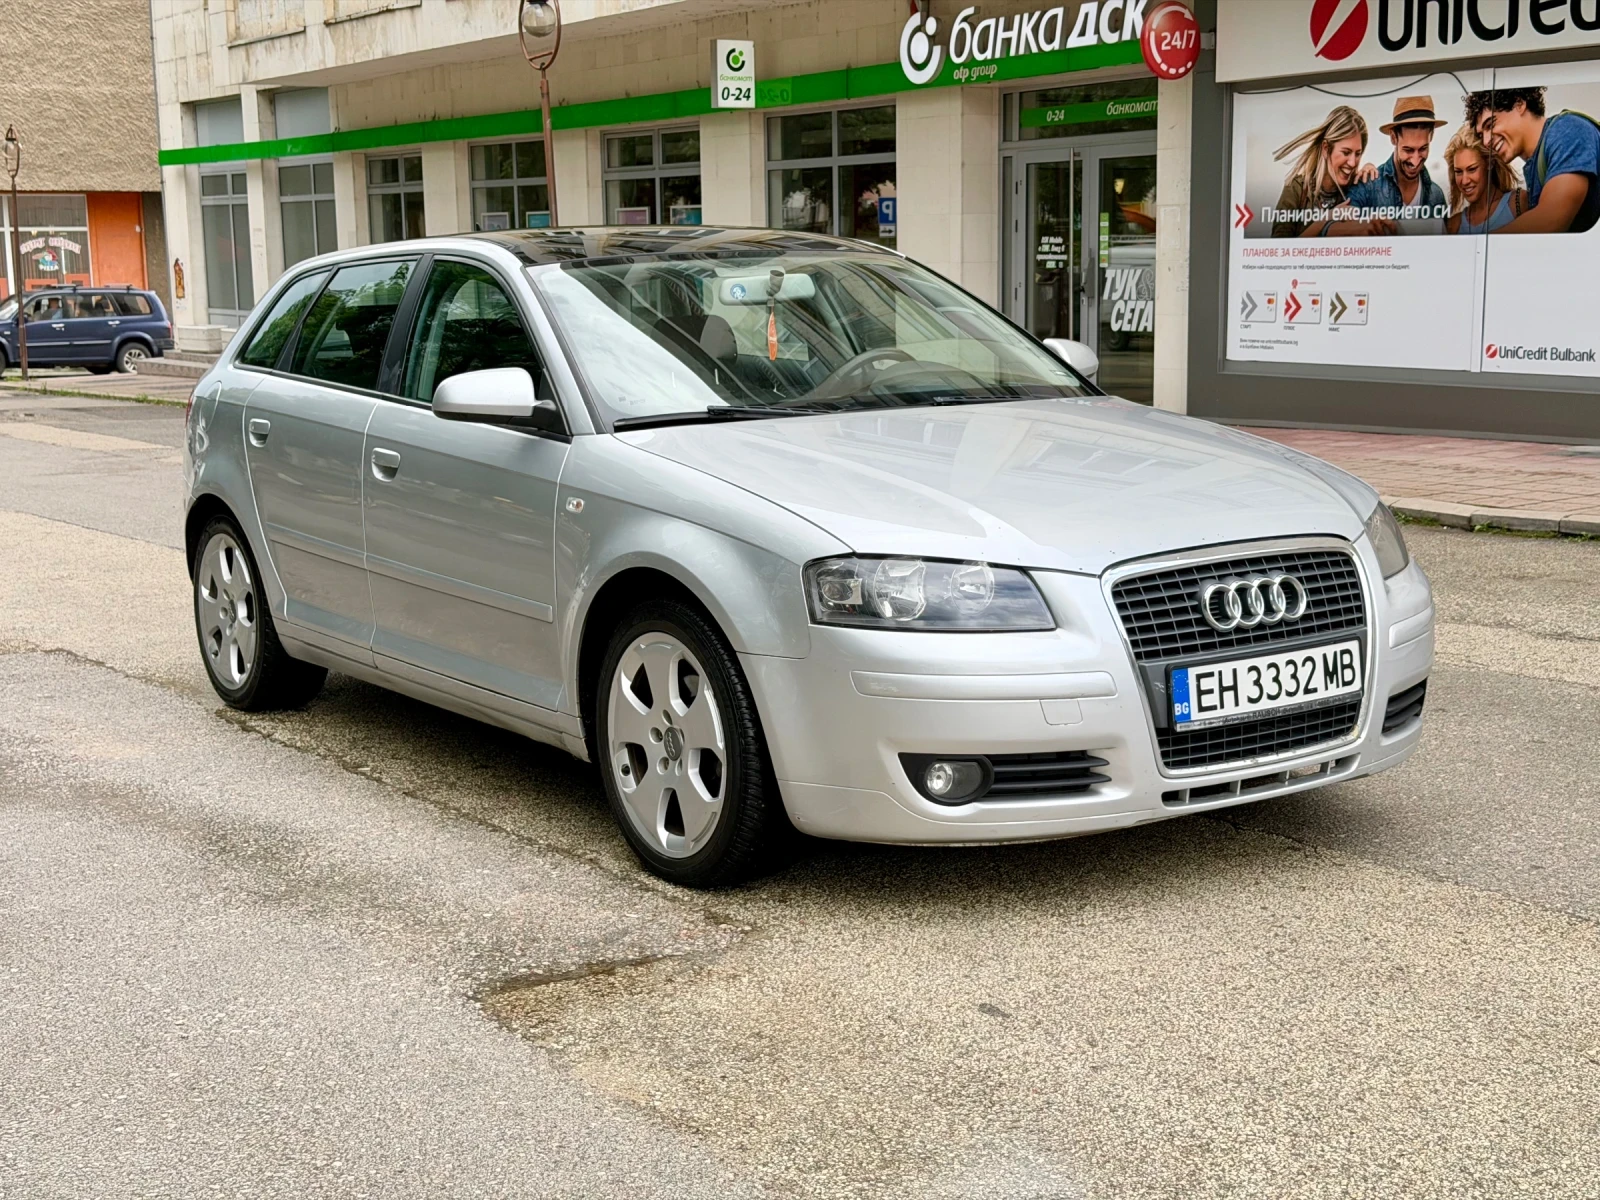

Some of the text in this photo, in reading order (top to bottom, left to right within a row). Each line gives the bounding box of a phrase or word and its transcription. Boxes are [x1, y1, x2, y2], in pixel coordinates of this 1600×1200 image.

[950, 0, 1147, 64] банка ДСК
[1161, 29, 1196, 51] 24/7
[720, 74, 753, 82] банкомат
[953, 64, 998, 82] otp group
[721, 86, 752, 101] 0-24
[1046, 110, 1065, 122] 0-24
[1261, 204, 1451, 225] Планирай ежедневието си
[1243, 246, 1392, 259] ПЛАНОВЕ ЗА ЕЖЕДНЕВНО БАНКИРАНЕ
[1103, 269, 1142, 300] ТУК
[1111, 300, 1153, 331] СЕГА
[1499, 346, 1596, 362] UniCredit Bulbank
[1196, 648, 1356, 713] EH 3332 MB
[1174, 702, 1189, 715] BG
